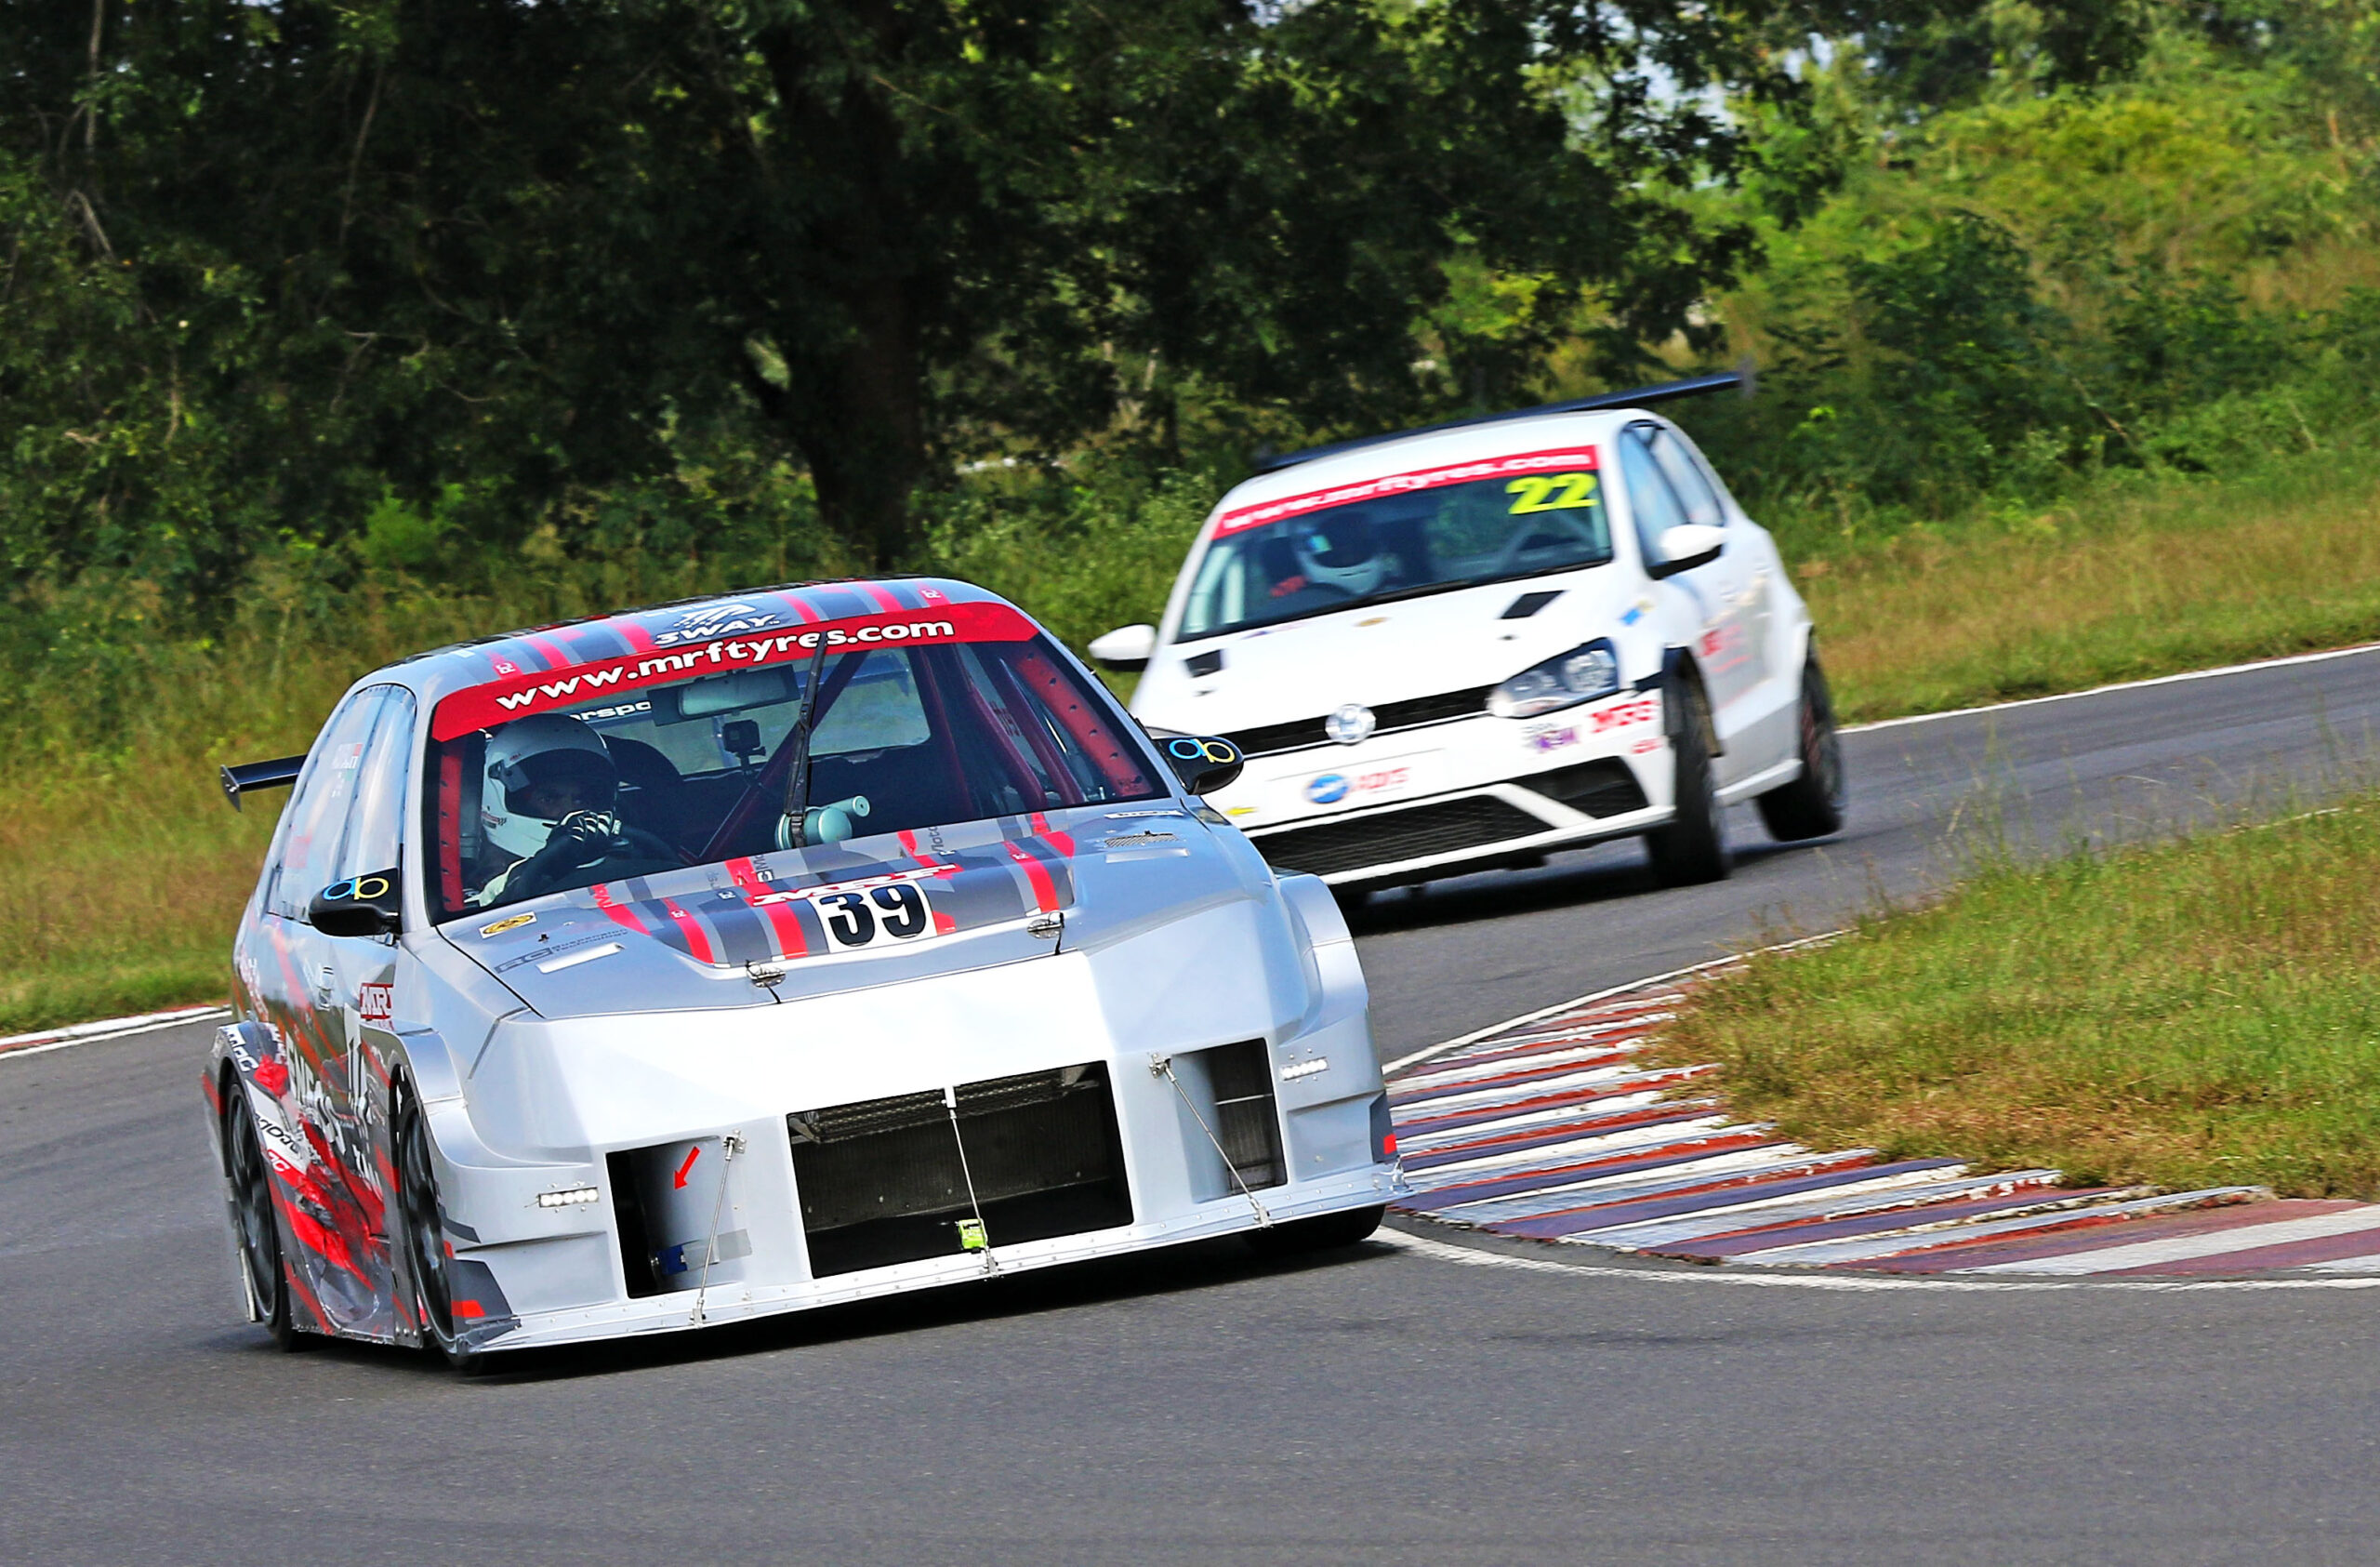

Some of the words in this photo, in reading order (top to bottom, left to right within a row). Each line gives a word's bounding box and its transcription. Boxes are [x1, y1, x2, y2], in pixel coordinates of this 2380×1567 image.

[1505, 472, 1597, 515] 22
[496, 617, 955, 710] www.mrftyres.com
[752, 862, 957, 906] MRF
[819, 883, 927, 948] 39
